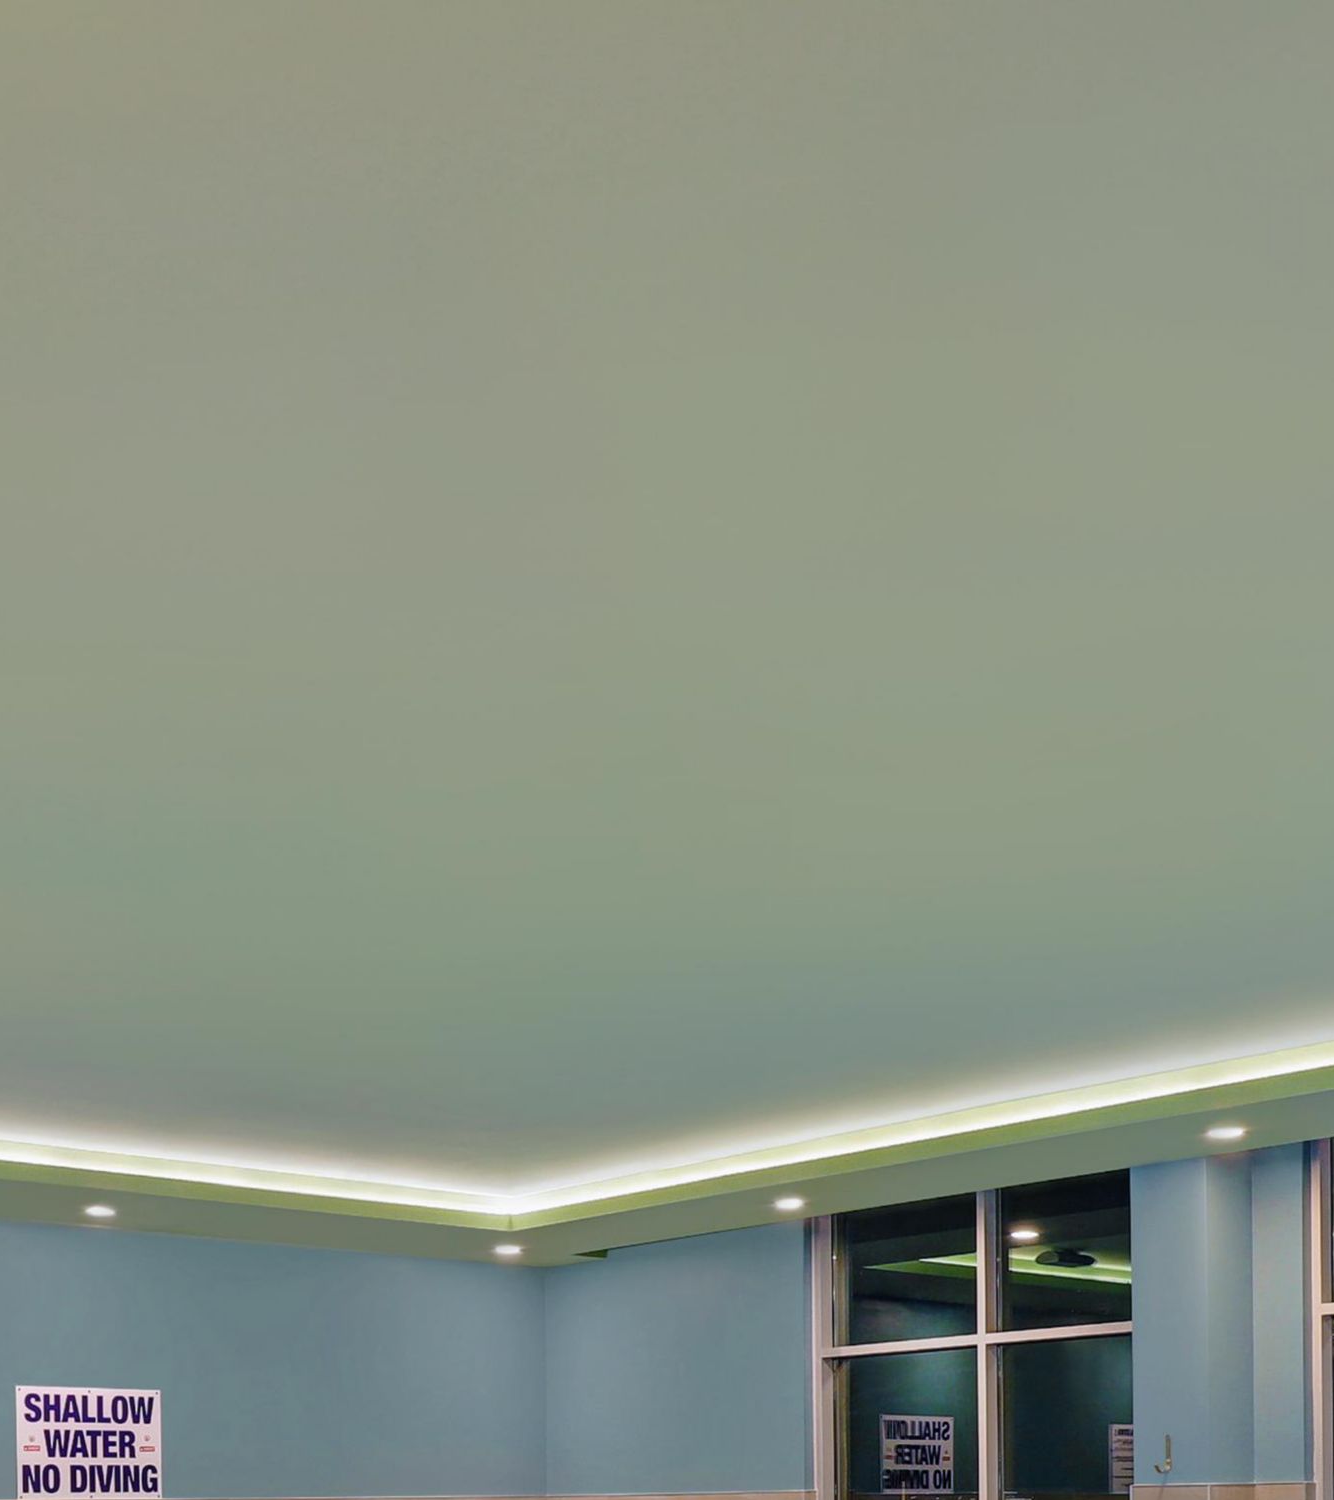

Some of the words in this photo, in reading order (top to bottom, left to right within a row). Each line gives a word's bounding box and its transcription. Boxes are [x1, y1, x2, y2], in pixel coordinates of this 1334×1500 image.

[24, 1393, 154, 1424] SHALLOW
[44, 1430, 136, 1458] WATER
[22, 1464, 60, 1493] NO
[70, 1465, 158, 1493] DIVING
